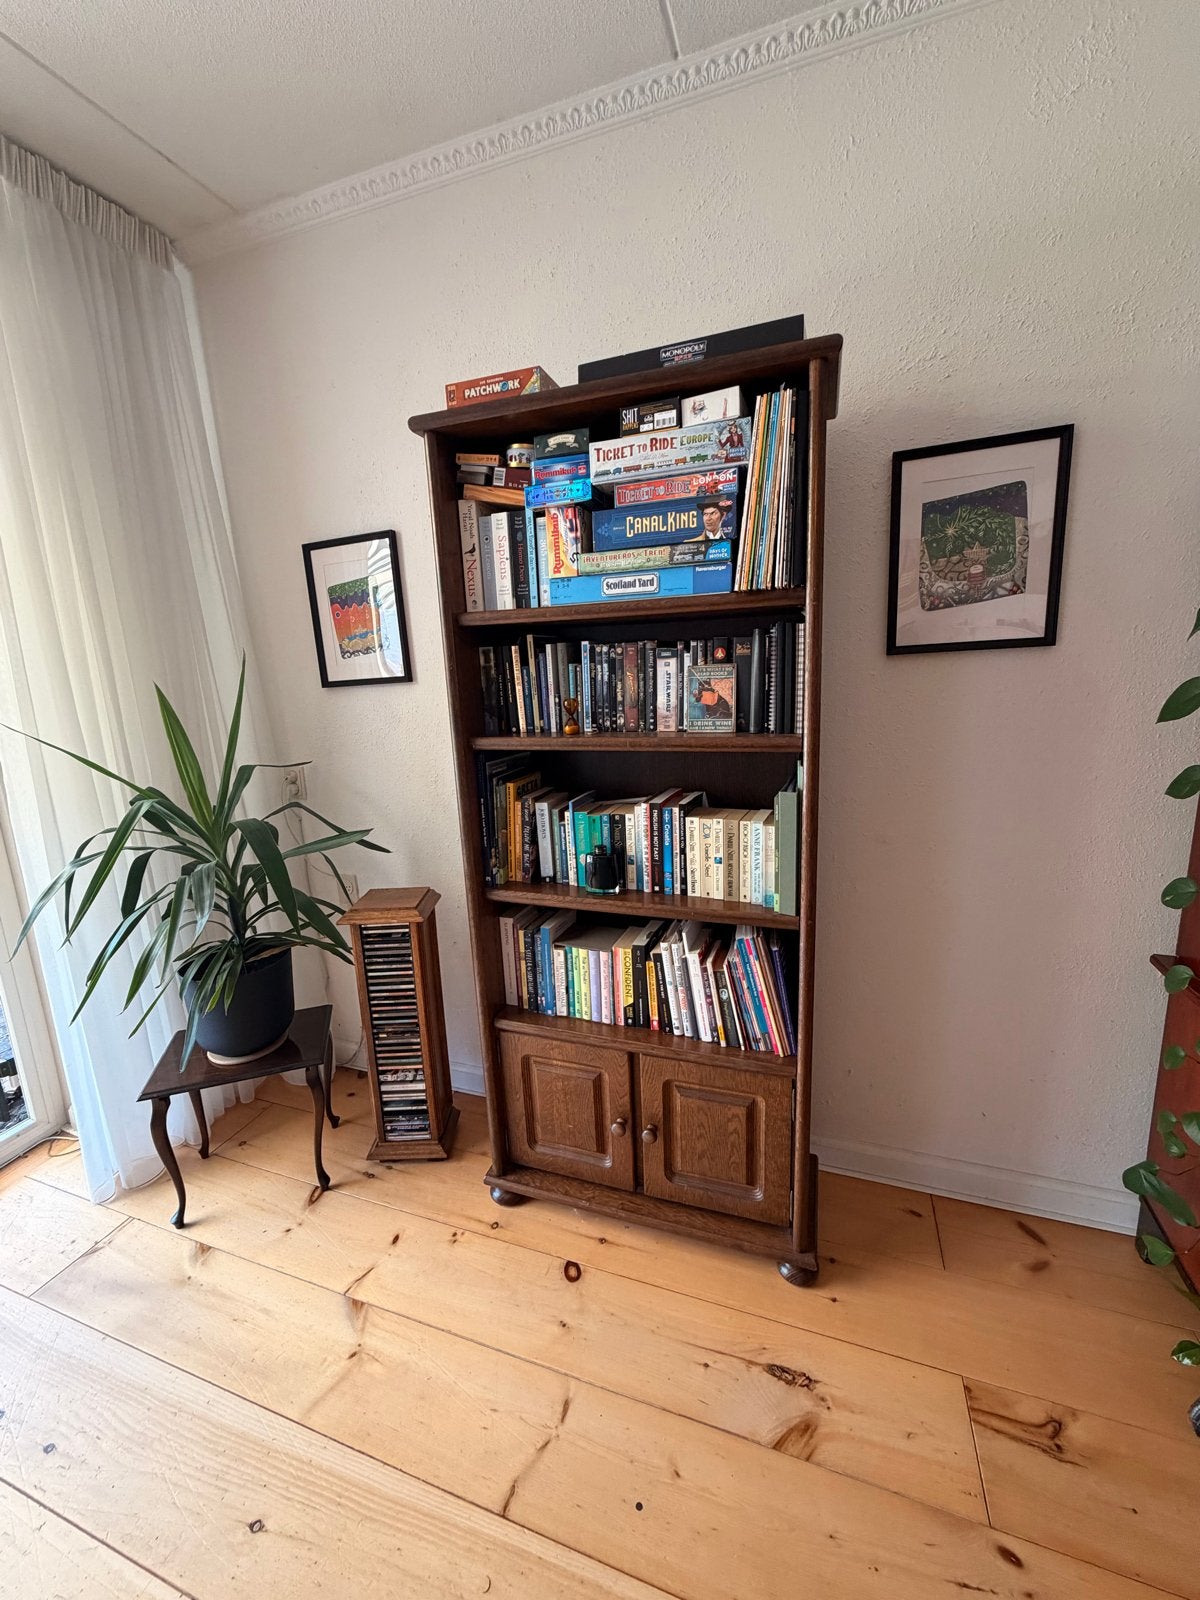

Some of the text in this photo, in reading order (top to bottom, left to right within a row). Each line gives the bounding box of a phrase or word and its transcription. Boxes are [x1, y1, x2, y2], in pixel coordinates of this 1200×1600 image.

[662, 343, 705, 359] MONOPOLY
[464, 378, 521, 400] PATCHWORK
[622, 407, 638, 425] SHIT
[593, 432, 714, 462] TICKET TO RIDE EUROPE
[693, 471, 733, 485] LONDON
[551, 512, 564, 575] Rummikub
[496, 535, 508, 581] Sapiens
[466, 558, 477, 597] Nexus
[605, 577, 655, 591] Scotland Yard
[704, 864, 712, 878] Steel
[753, 847, 761, 872] FRANK
[624, 956, 632, 998] CONFIDENT
